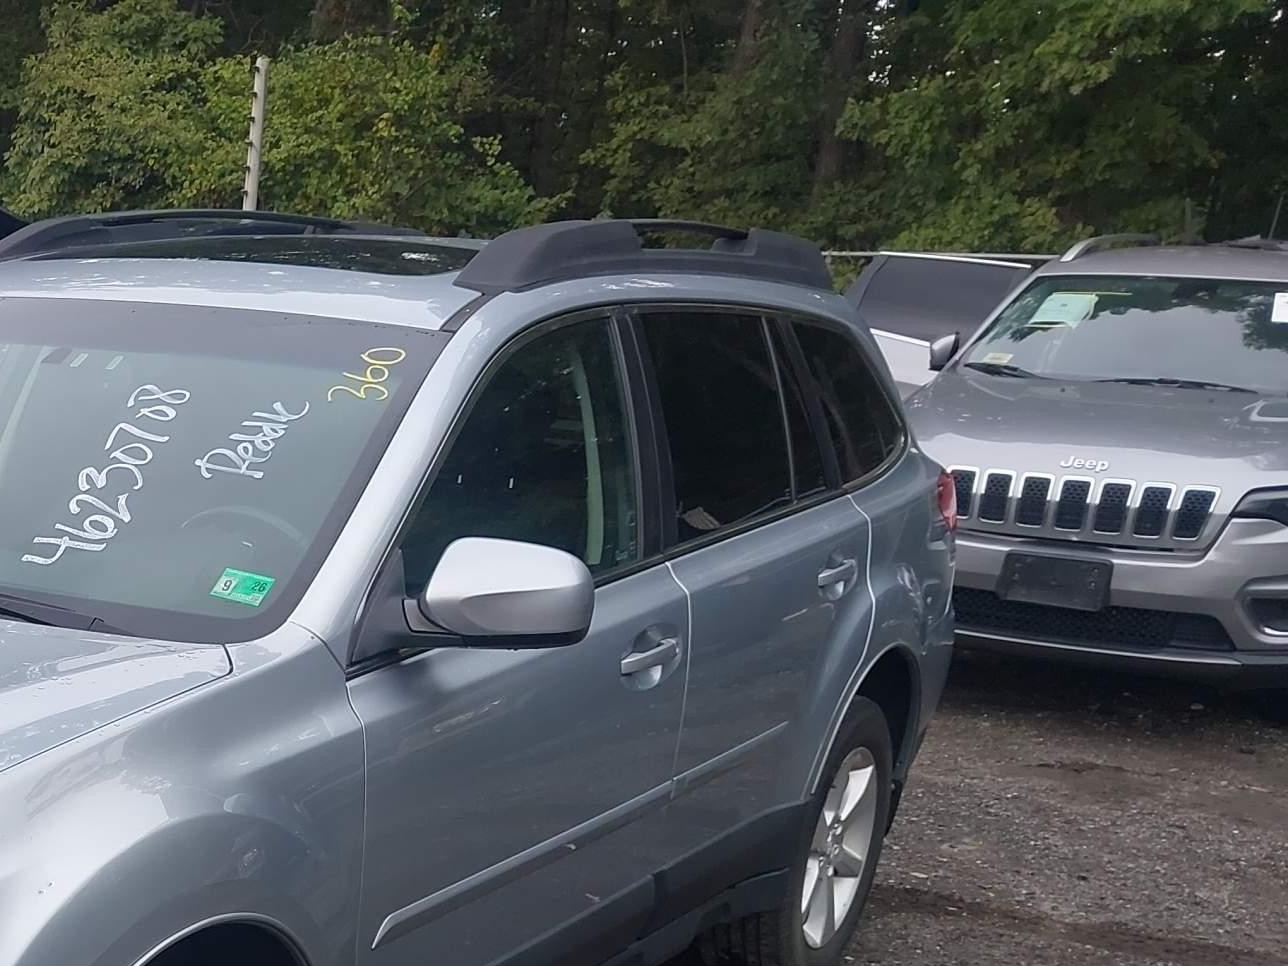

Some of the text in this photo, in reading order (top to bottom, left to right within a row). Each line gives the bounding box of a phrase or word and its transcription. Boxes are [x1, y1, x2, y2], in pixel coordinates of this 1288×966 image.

[327, 346, 407, 402] 360
[1059, 455, 1110, 474] Jeep
[222, 579, 268, 593] 9 26
